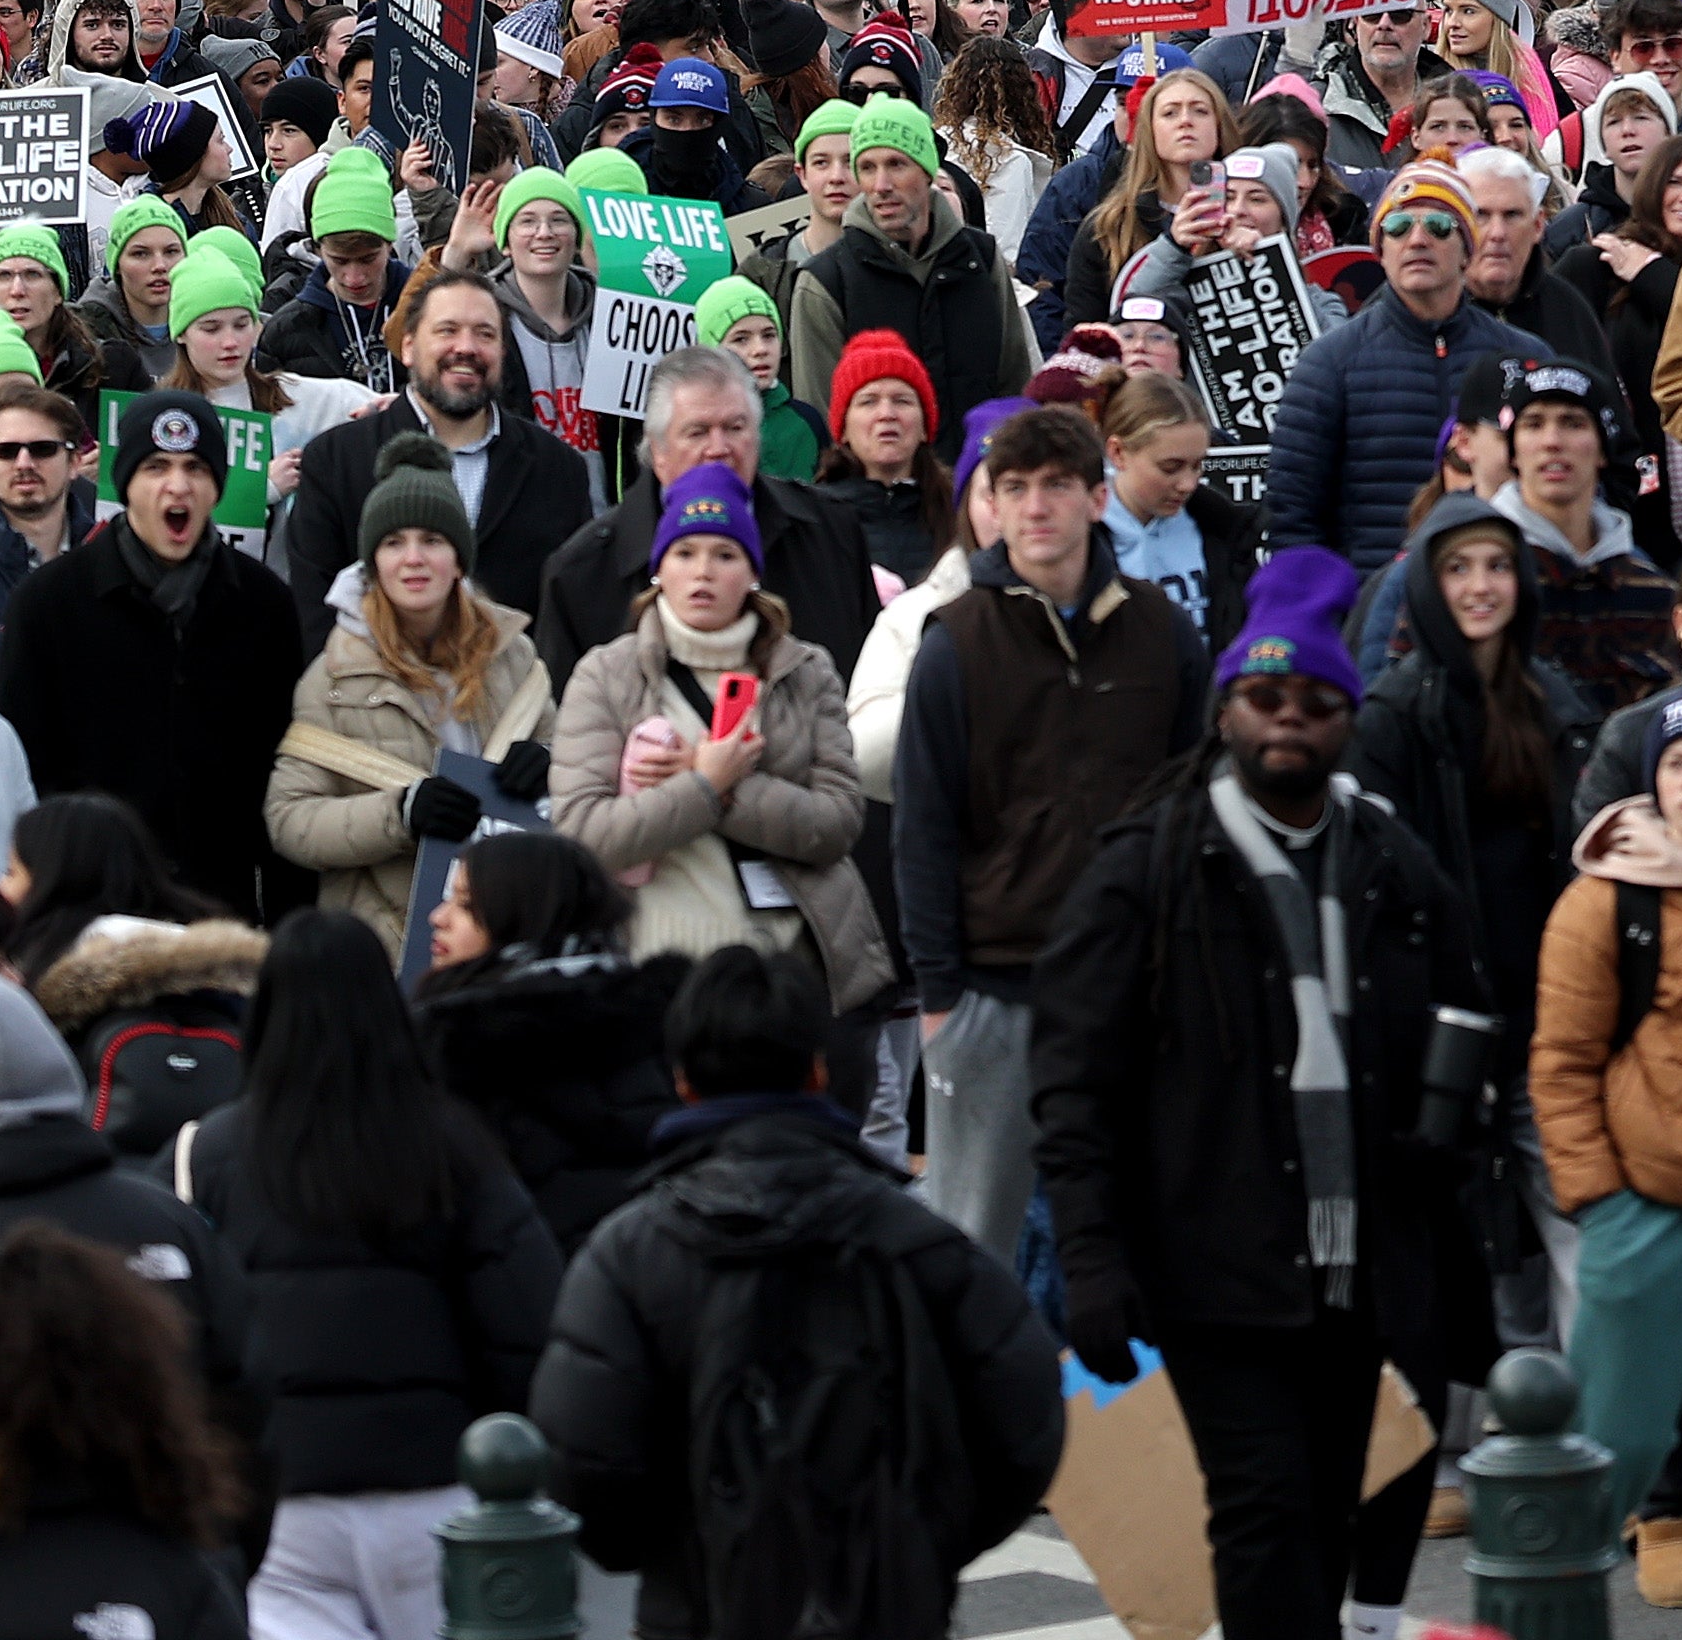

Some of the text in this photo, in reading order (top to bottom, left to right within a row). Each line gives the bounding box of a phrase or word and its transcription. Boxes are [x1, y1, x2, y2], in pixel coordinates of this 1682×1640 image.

[671, 71, 714, 88] AMERICA
[677, 80, 705, 92] FIRST
[0, 113, 69, 138] THE
[586, 196, 663, 243] LOVE
[661, 204, 725, 252] LIFE
[608, 298, 697, 355] CHOOS
[1189, 278, 1233, 356] THE
[1220, 370, 1262, 429] AM
